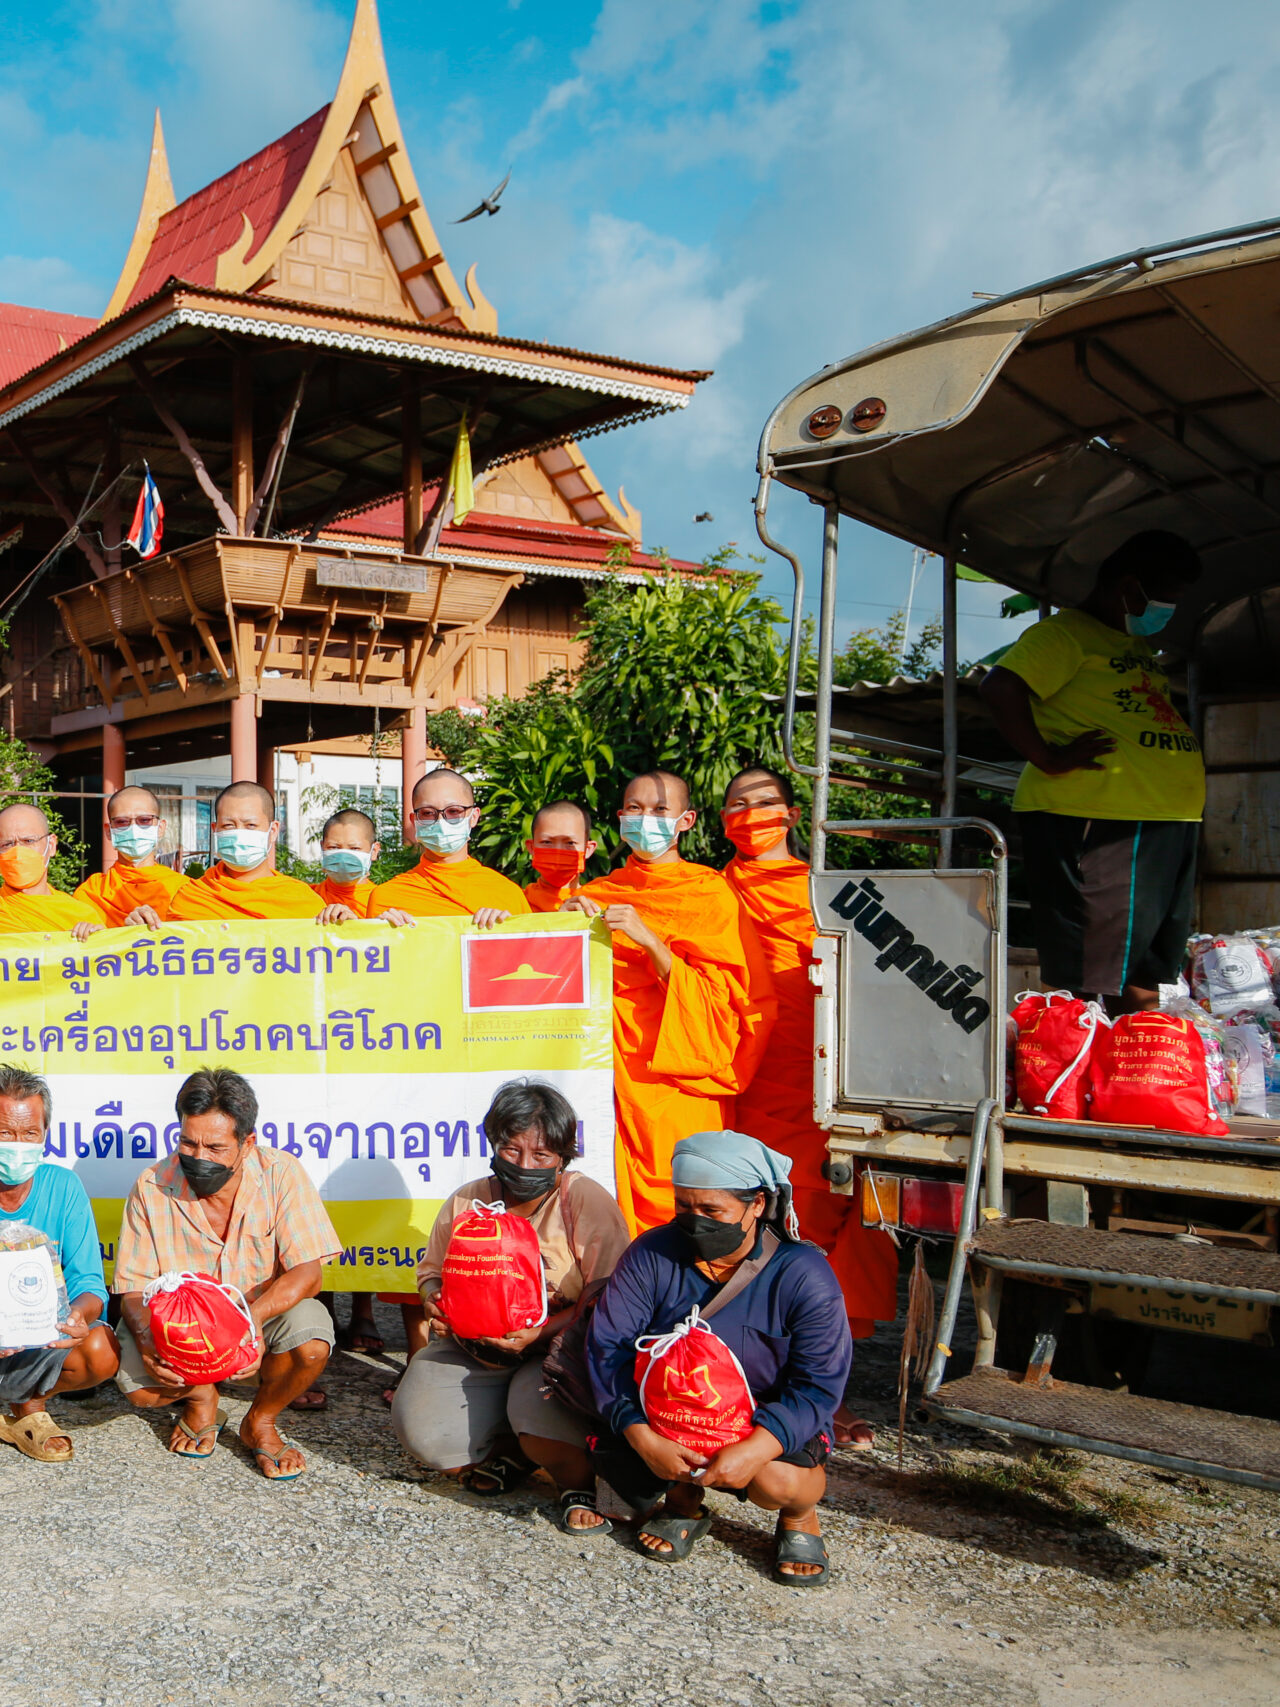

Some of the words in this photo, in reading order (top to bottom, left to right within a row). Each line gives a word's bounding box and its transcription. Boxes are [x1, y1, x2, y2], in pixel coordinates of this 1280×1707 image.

[61, 936, 391, 994] มูลนิธิธรรมกาย
[1139, 1303, 1216, 1331] ปราจีนบุรี
